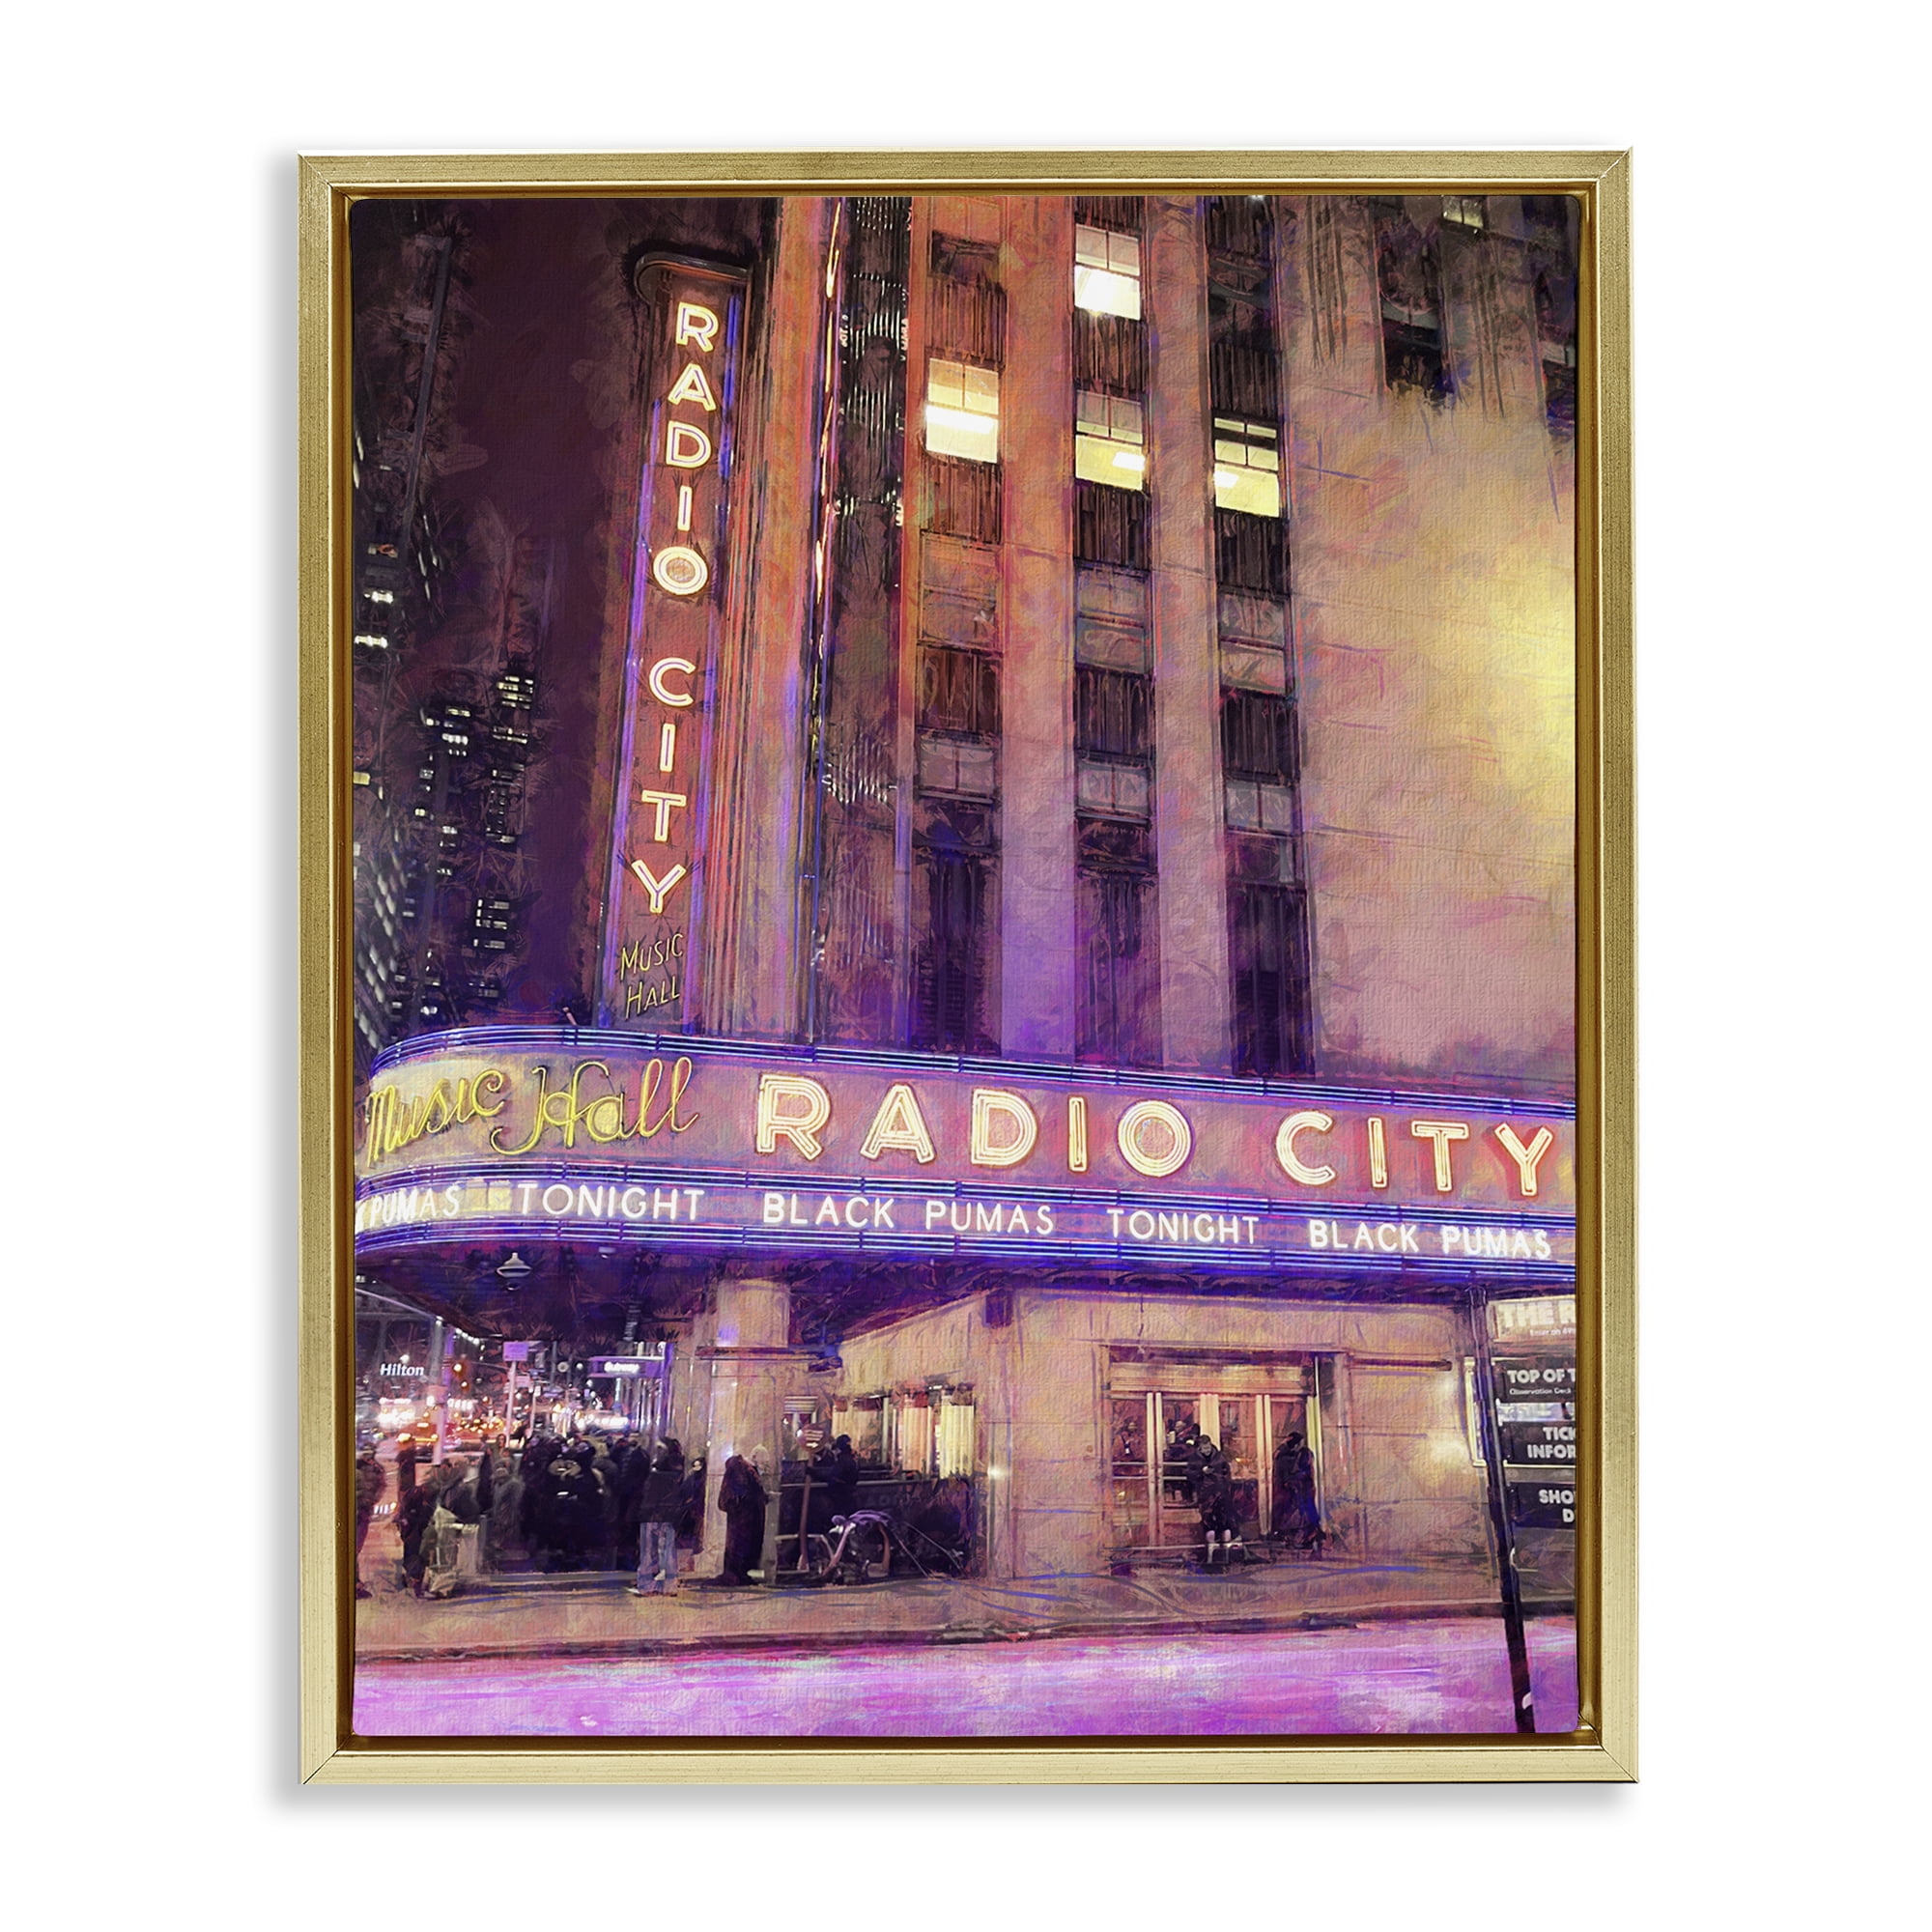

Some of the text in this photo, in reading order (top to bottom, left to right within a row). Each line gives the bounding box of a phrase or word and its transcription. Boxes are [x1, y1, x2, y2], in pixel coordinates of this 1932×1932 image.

[631, 301, 719, 914] RADIO CITY
[365, 1057, 699, 1167] Music Hall
[756, 1074, 1553, 1196] RADIO CITY
[369, 1183, 460, 1229] PUMAS
[517, 1182, 705, 1221] TONIGHT
[762, 1191, 895, 1230] BLACK
[924, 1200, 1054, 1235] PUMAS
[1106, 1207, 1259, 1244] TONIGHT
[1309, 1218, 1418, 1253] BLACK
[1442, 1223, 1551, 1260] PUMAS
[1498, 1300, 1554, 1328] THE
[380, 1363, 425, 1376] Hilton
[1507, 1369, 1540, 1383] TOP
[1543, 1368, 1565, 1383] OF
[1538, 1489, 1576, 1504] SHO
